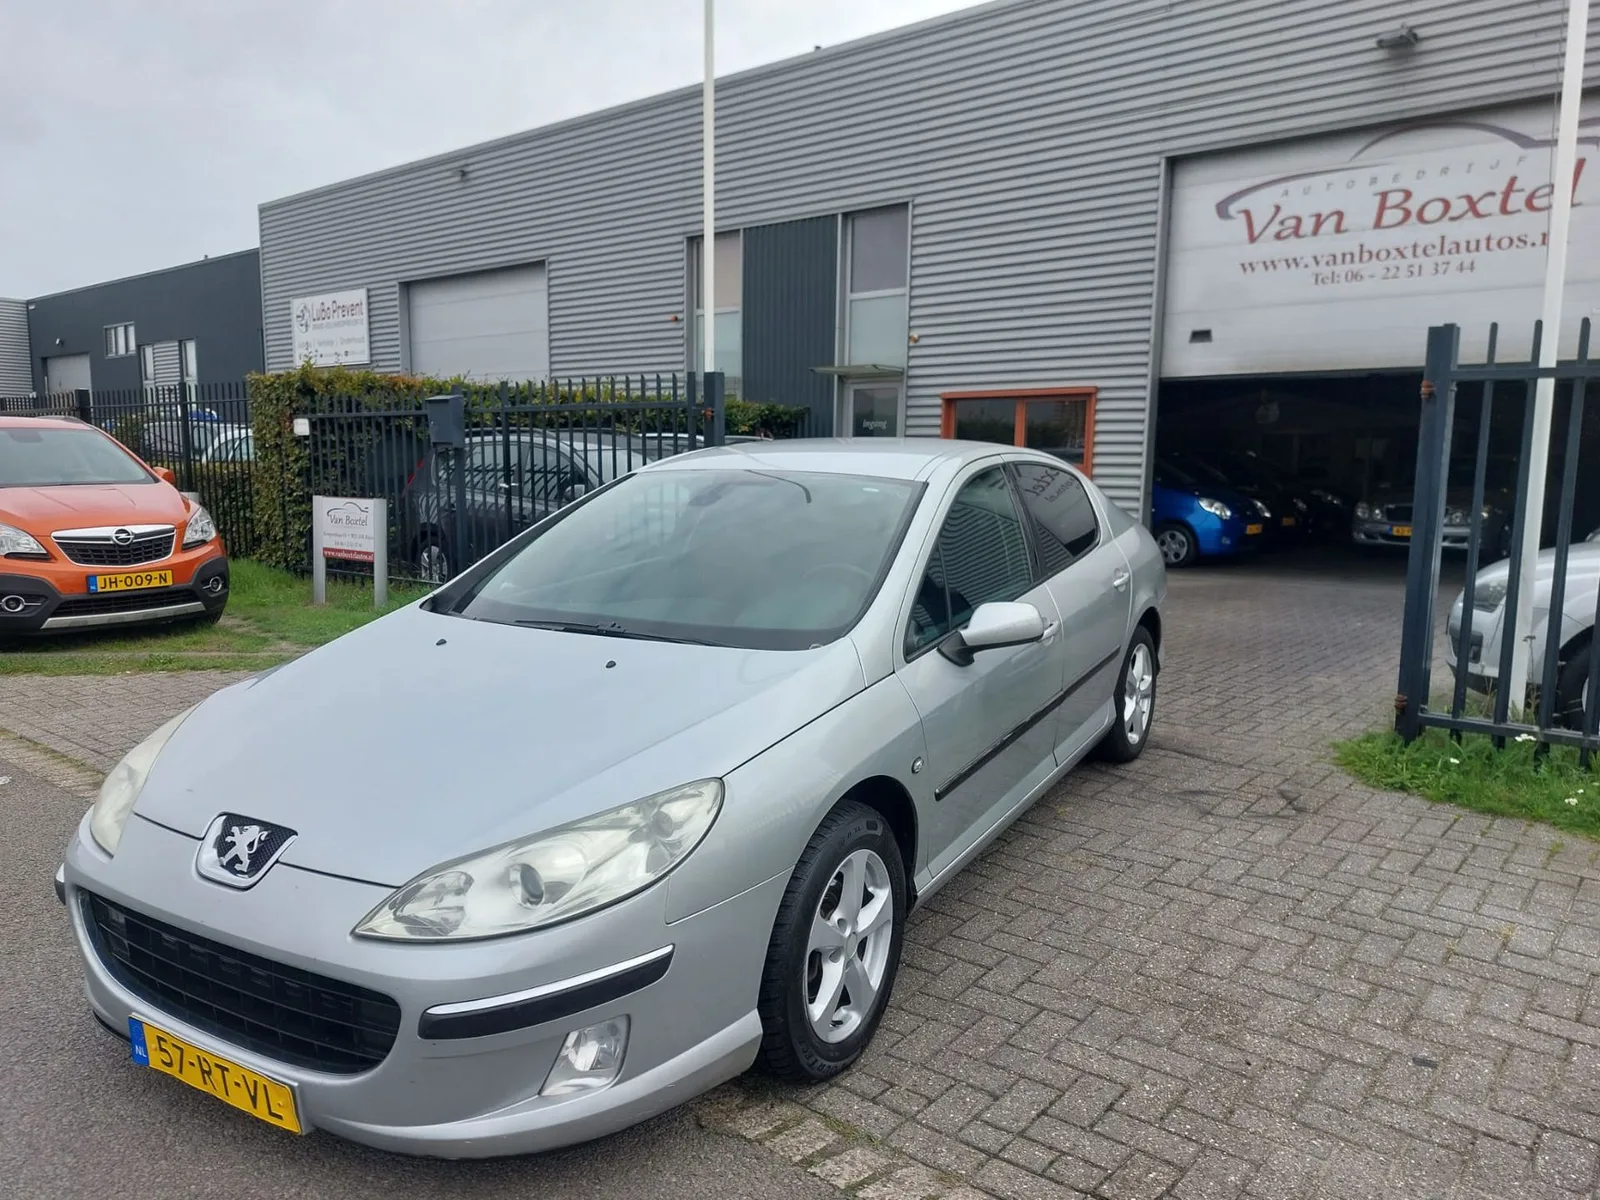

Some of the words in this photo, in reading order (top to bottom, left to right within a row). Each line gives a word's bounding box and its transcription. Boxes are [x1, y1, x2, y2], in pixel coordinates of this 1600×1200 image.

[1280, 155, 1527, 197] AUTOBEDRIJF
[1236, 203, 1348, 244] Van
[1372, 157, 1586, 230] Boxtel
[1239, 231, 1550, 275] www.vanboxtelautos.
[1312, 270, 1340, 286] Tel:
[1345, 272, 1363, 283] 06
[1381, 266, 1400, 280] 22
[1406, 263, 1423, 278] 51
[1432, 260, 1450, 275] 37
[1456, 259, 1476, 273] 44
[329, 514, 343, 524] Van
[345, 515, 368, 526] Boxtel
[100, 572, 168, 589] JH-009-N
[135, 1044, 148, 1058] NL
[156, 1034, 284, 1121] 57-RT-VL
